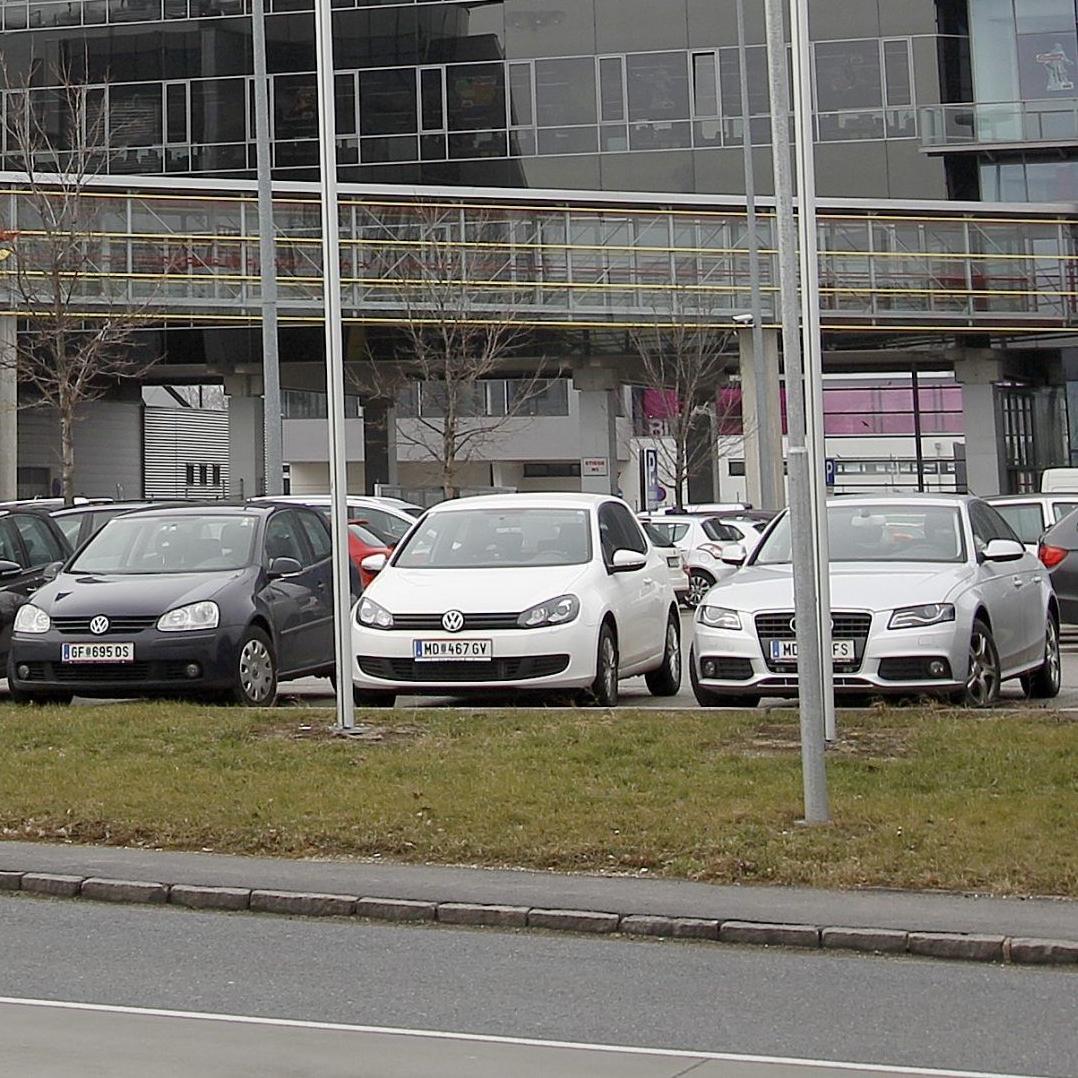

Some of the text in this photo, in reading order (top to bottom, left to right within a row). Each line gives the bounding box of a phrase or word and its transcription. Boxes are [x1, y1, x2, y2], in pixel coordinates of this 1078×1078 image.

[71, 646, 84, 658] GF
[92, 646, 113, 658] 695
[448, 643, 469, 655] 467
[472, 643, 487, 655] GV
